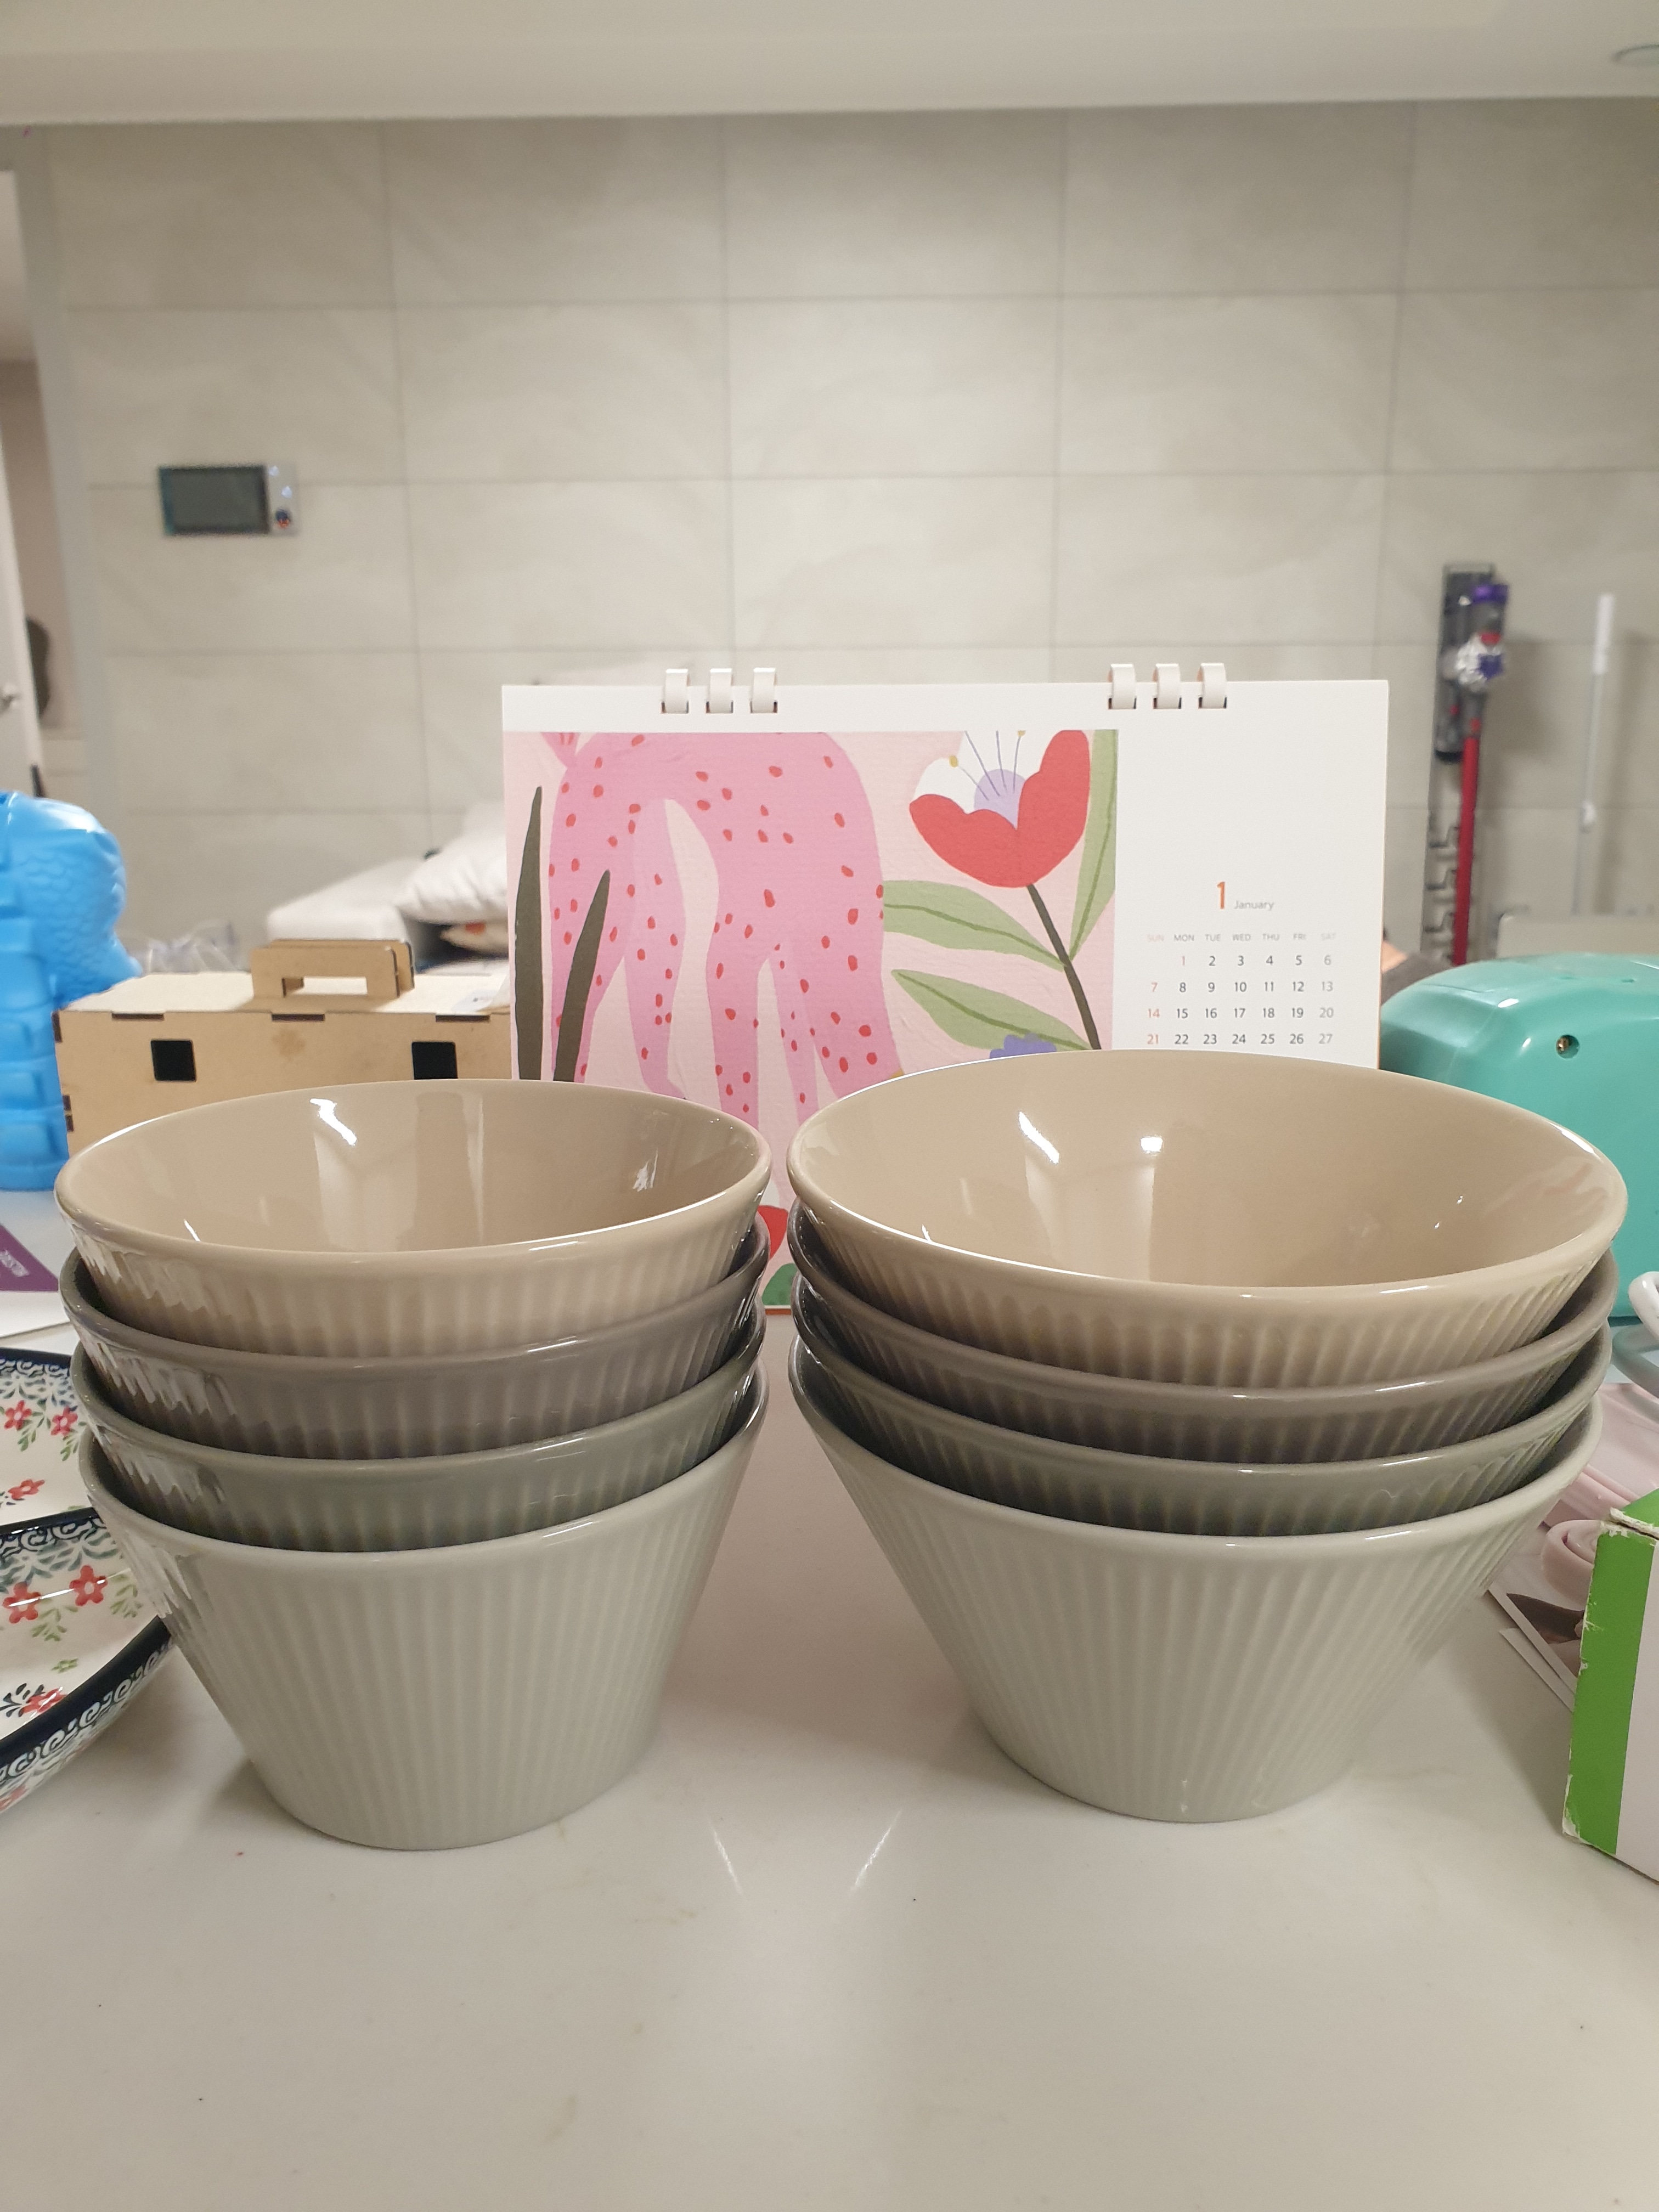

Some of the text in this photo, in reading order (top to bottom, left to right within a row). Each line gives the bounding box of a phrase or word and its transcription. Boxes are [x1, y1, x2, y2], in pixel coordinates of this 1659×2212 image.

[1217, 881, 1275, 911] 1 January
[1147, 932, 1336, 943] SUN MON TUE WED THU FRI SAT
[1181, 954, 1332, 967] 1 2 3 4 5 6
[1151, 980, 1334, 993] 7 8 9 10 11 12 13
[1148, 1007, 1334, 1019] 14 15 16 17 18 19 20
[1147, 1032, 1333, 1045] 21 22 23 24 25 26 27
